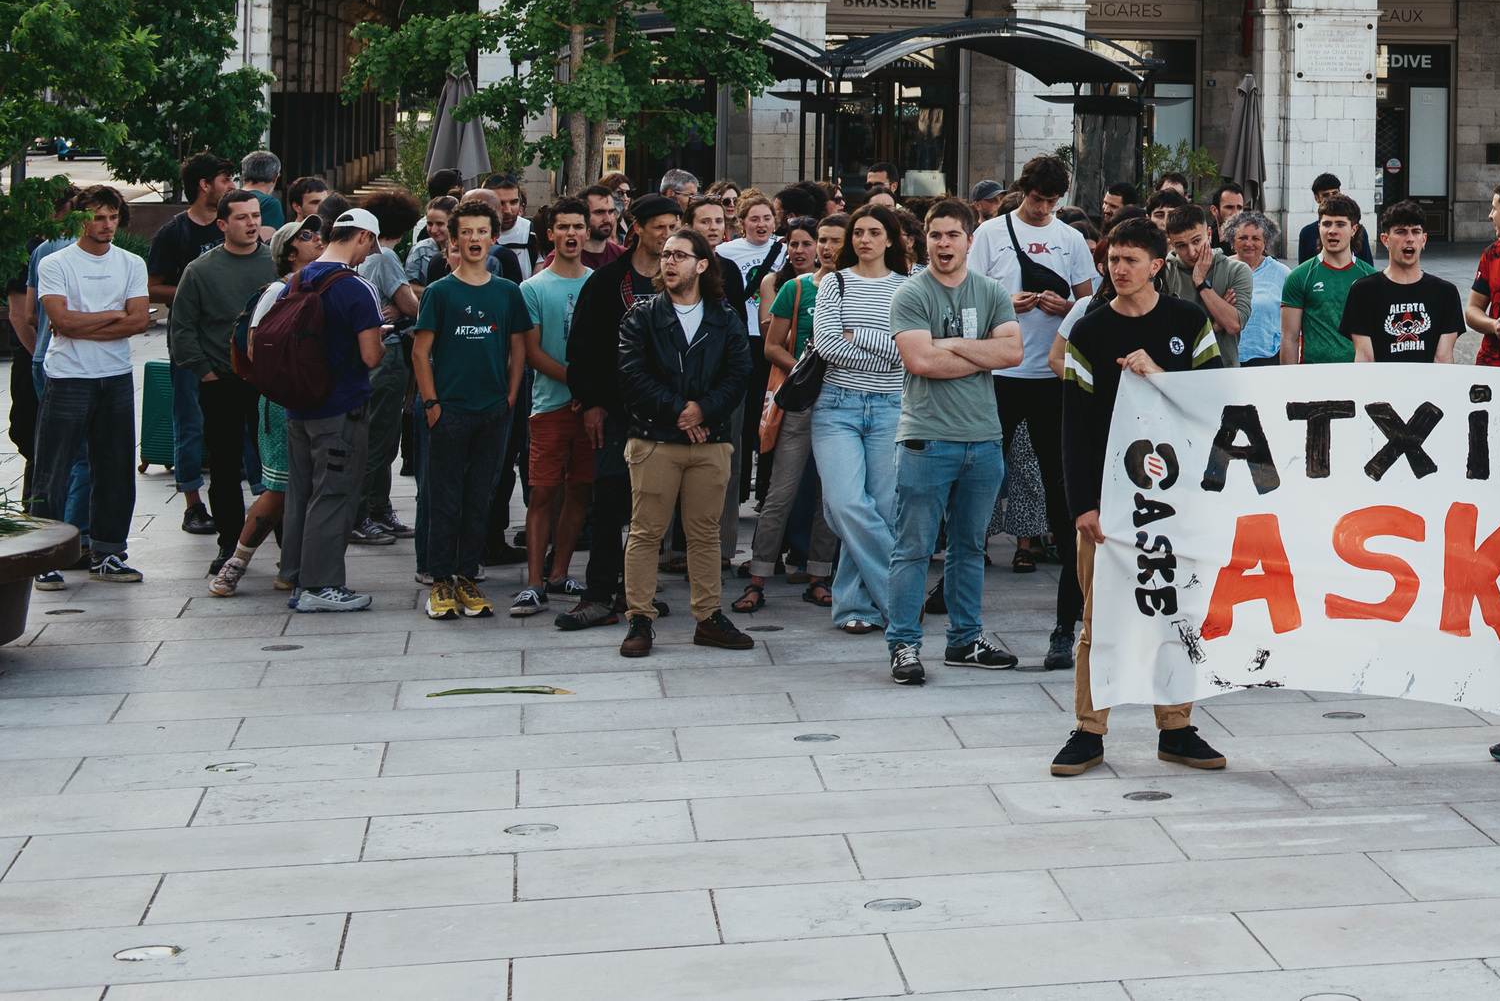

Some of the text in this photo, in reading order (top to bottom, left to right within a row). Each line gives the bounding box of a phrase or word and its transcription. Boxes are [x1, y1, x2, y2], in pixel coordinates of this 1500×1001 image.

[1087, 3, 1162, 17] CIGARES
[1389, 303, 1426, 314] ALERTA
[1390, 340, 1425, 353] GORRIA
